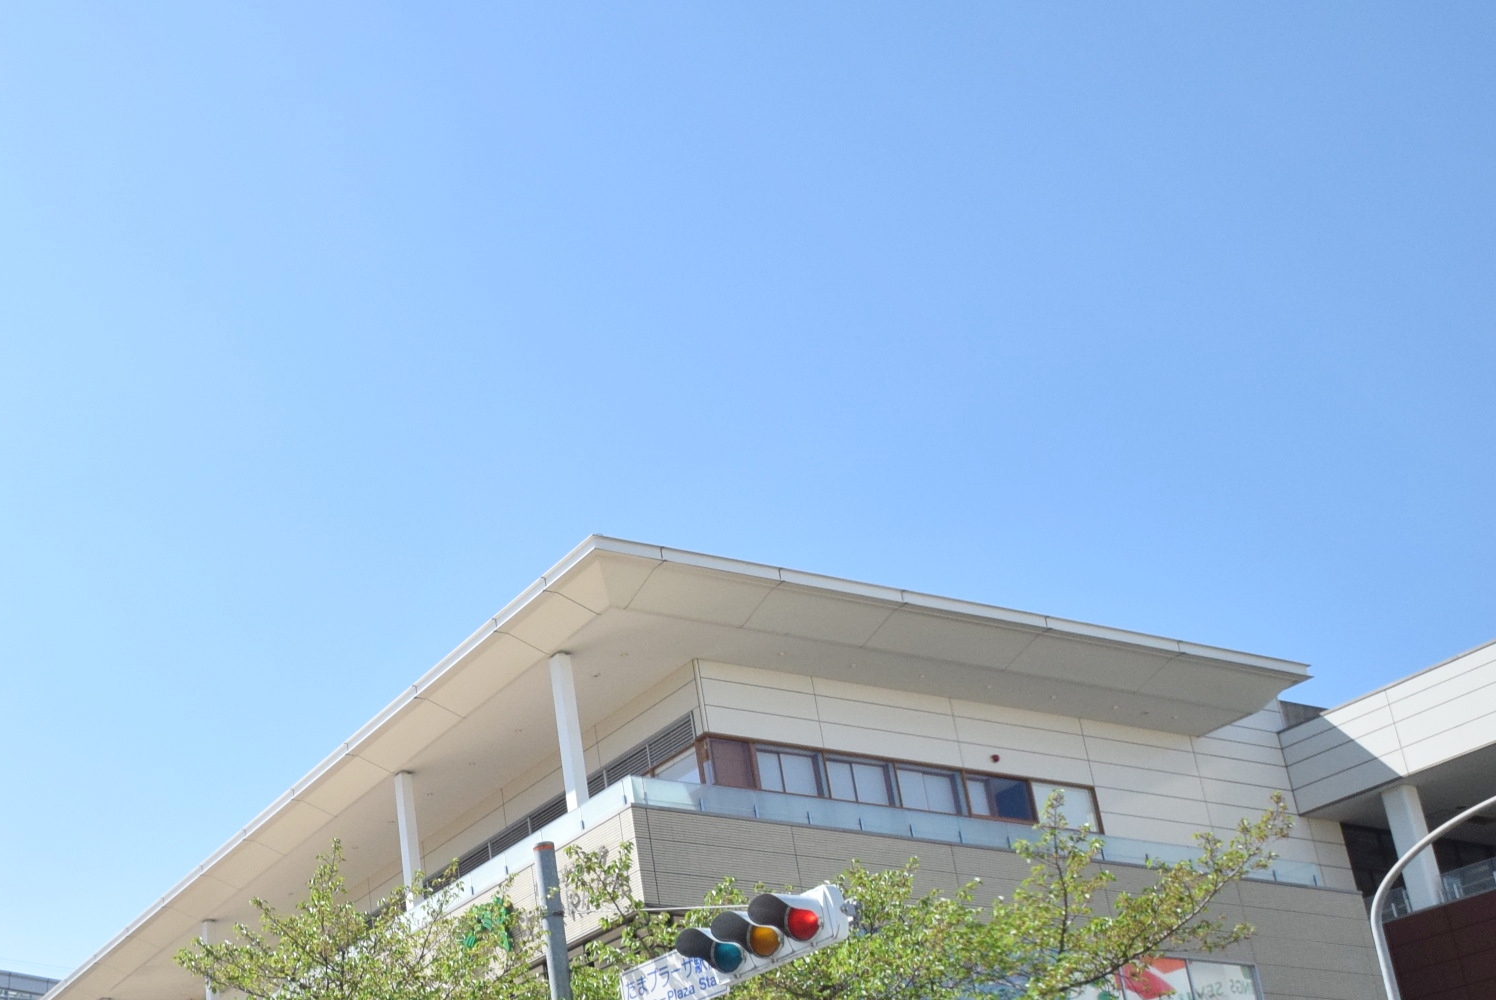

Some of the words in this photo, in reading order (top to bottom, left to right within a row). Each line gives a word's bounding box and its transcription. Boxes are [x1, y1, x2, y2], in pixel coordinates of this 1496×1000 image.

[626, 957, 711, 1000] たまプラーザ駅
